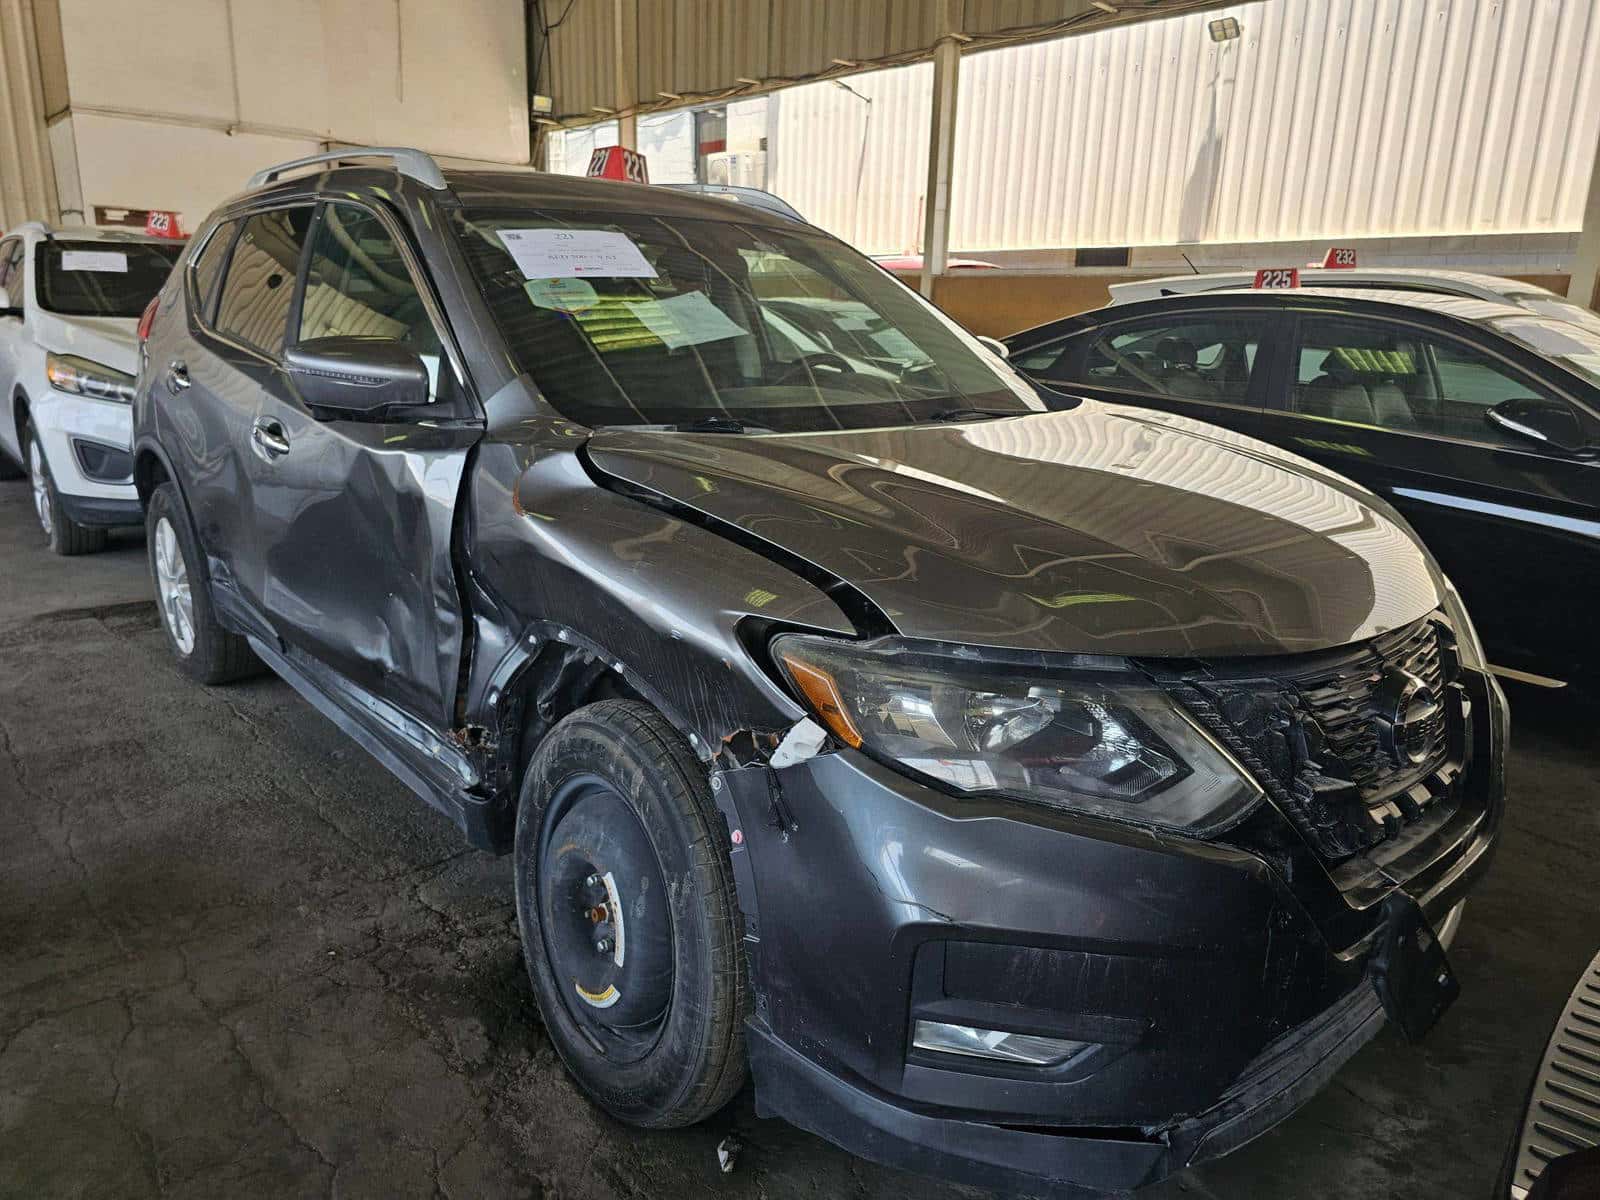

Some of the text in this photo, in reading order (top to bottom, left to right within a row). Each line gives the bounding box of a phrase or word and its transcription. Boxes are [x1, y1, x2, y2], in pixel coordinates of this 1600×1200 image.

[588, 149, 610, 177] 221
[623, 150, 647, 184] 221
[150, 212, 169, 231] 223
[1335, 249, 1355, 265] 232
[1261, 271, 1292, 288] 225
